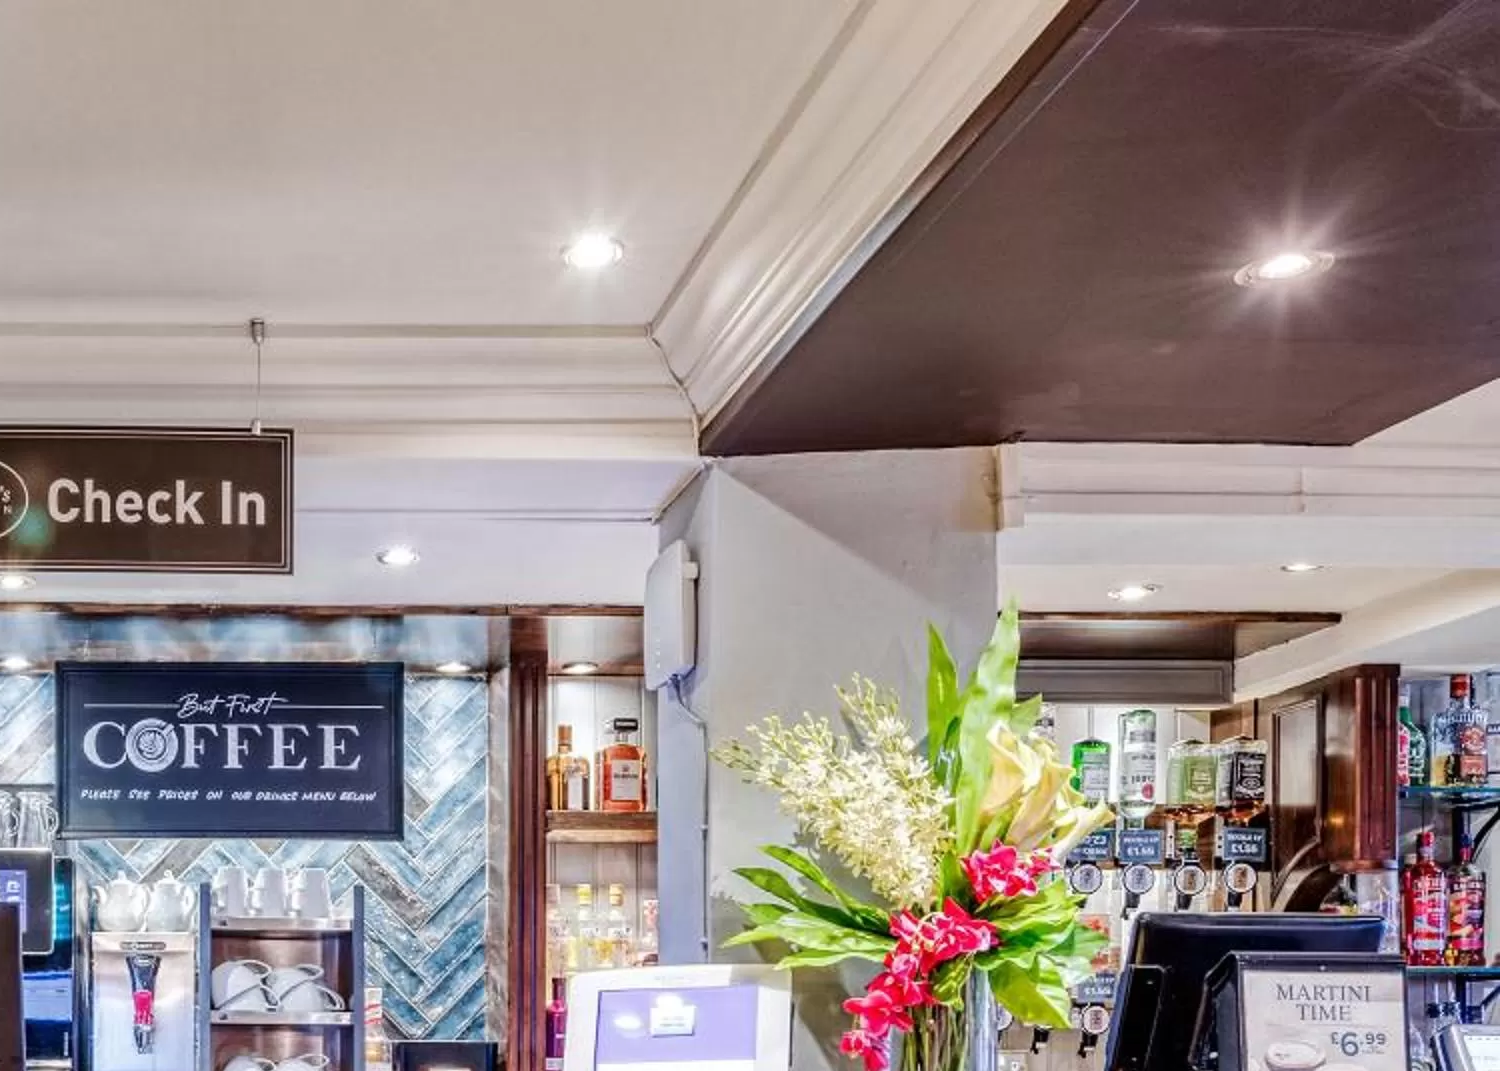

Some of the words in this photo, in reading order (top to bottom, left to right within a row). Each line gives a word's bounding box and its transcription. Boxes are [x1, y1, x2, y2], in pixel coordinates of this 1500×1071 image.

[47, 478, 204, 525] Check
[220, 479, 267, 526] In
[176, 692, 227, 719] But
[83, 718, 362, 773] COFFEE
[80, 788, 121, 800] PLEASE
[205, 790, 224, 801] ON
[301, 791, 337, 803] MENU
[339, 791, 377, 803] BELOW
[1275, 983, 1373, 1003] MARTINI
[1295, 1004, 1351, 1022] TIME
[1330, 1031, 1387, 1057] £6.99
